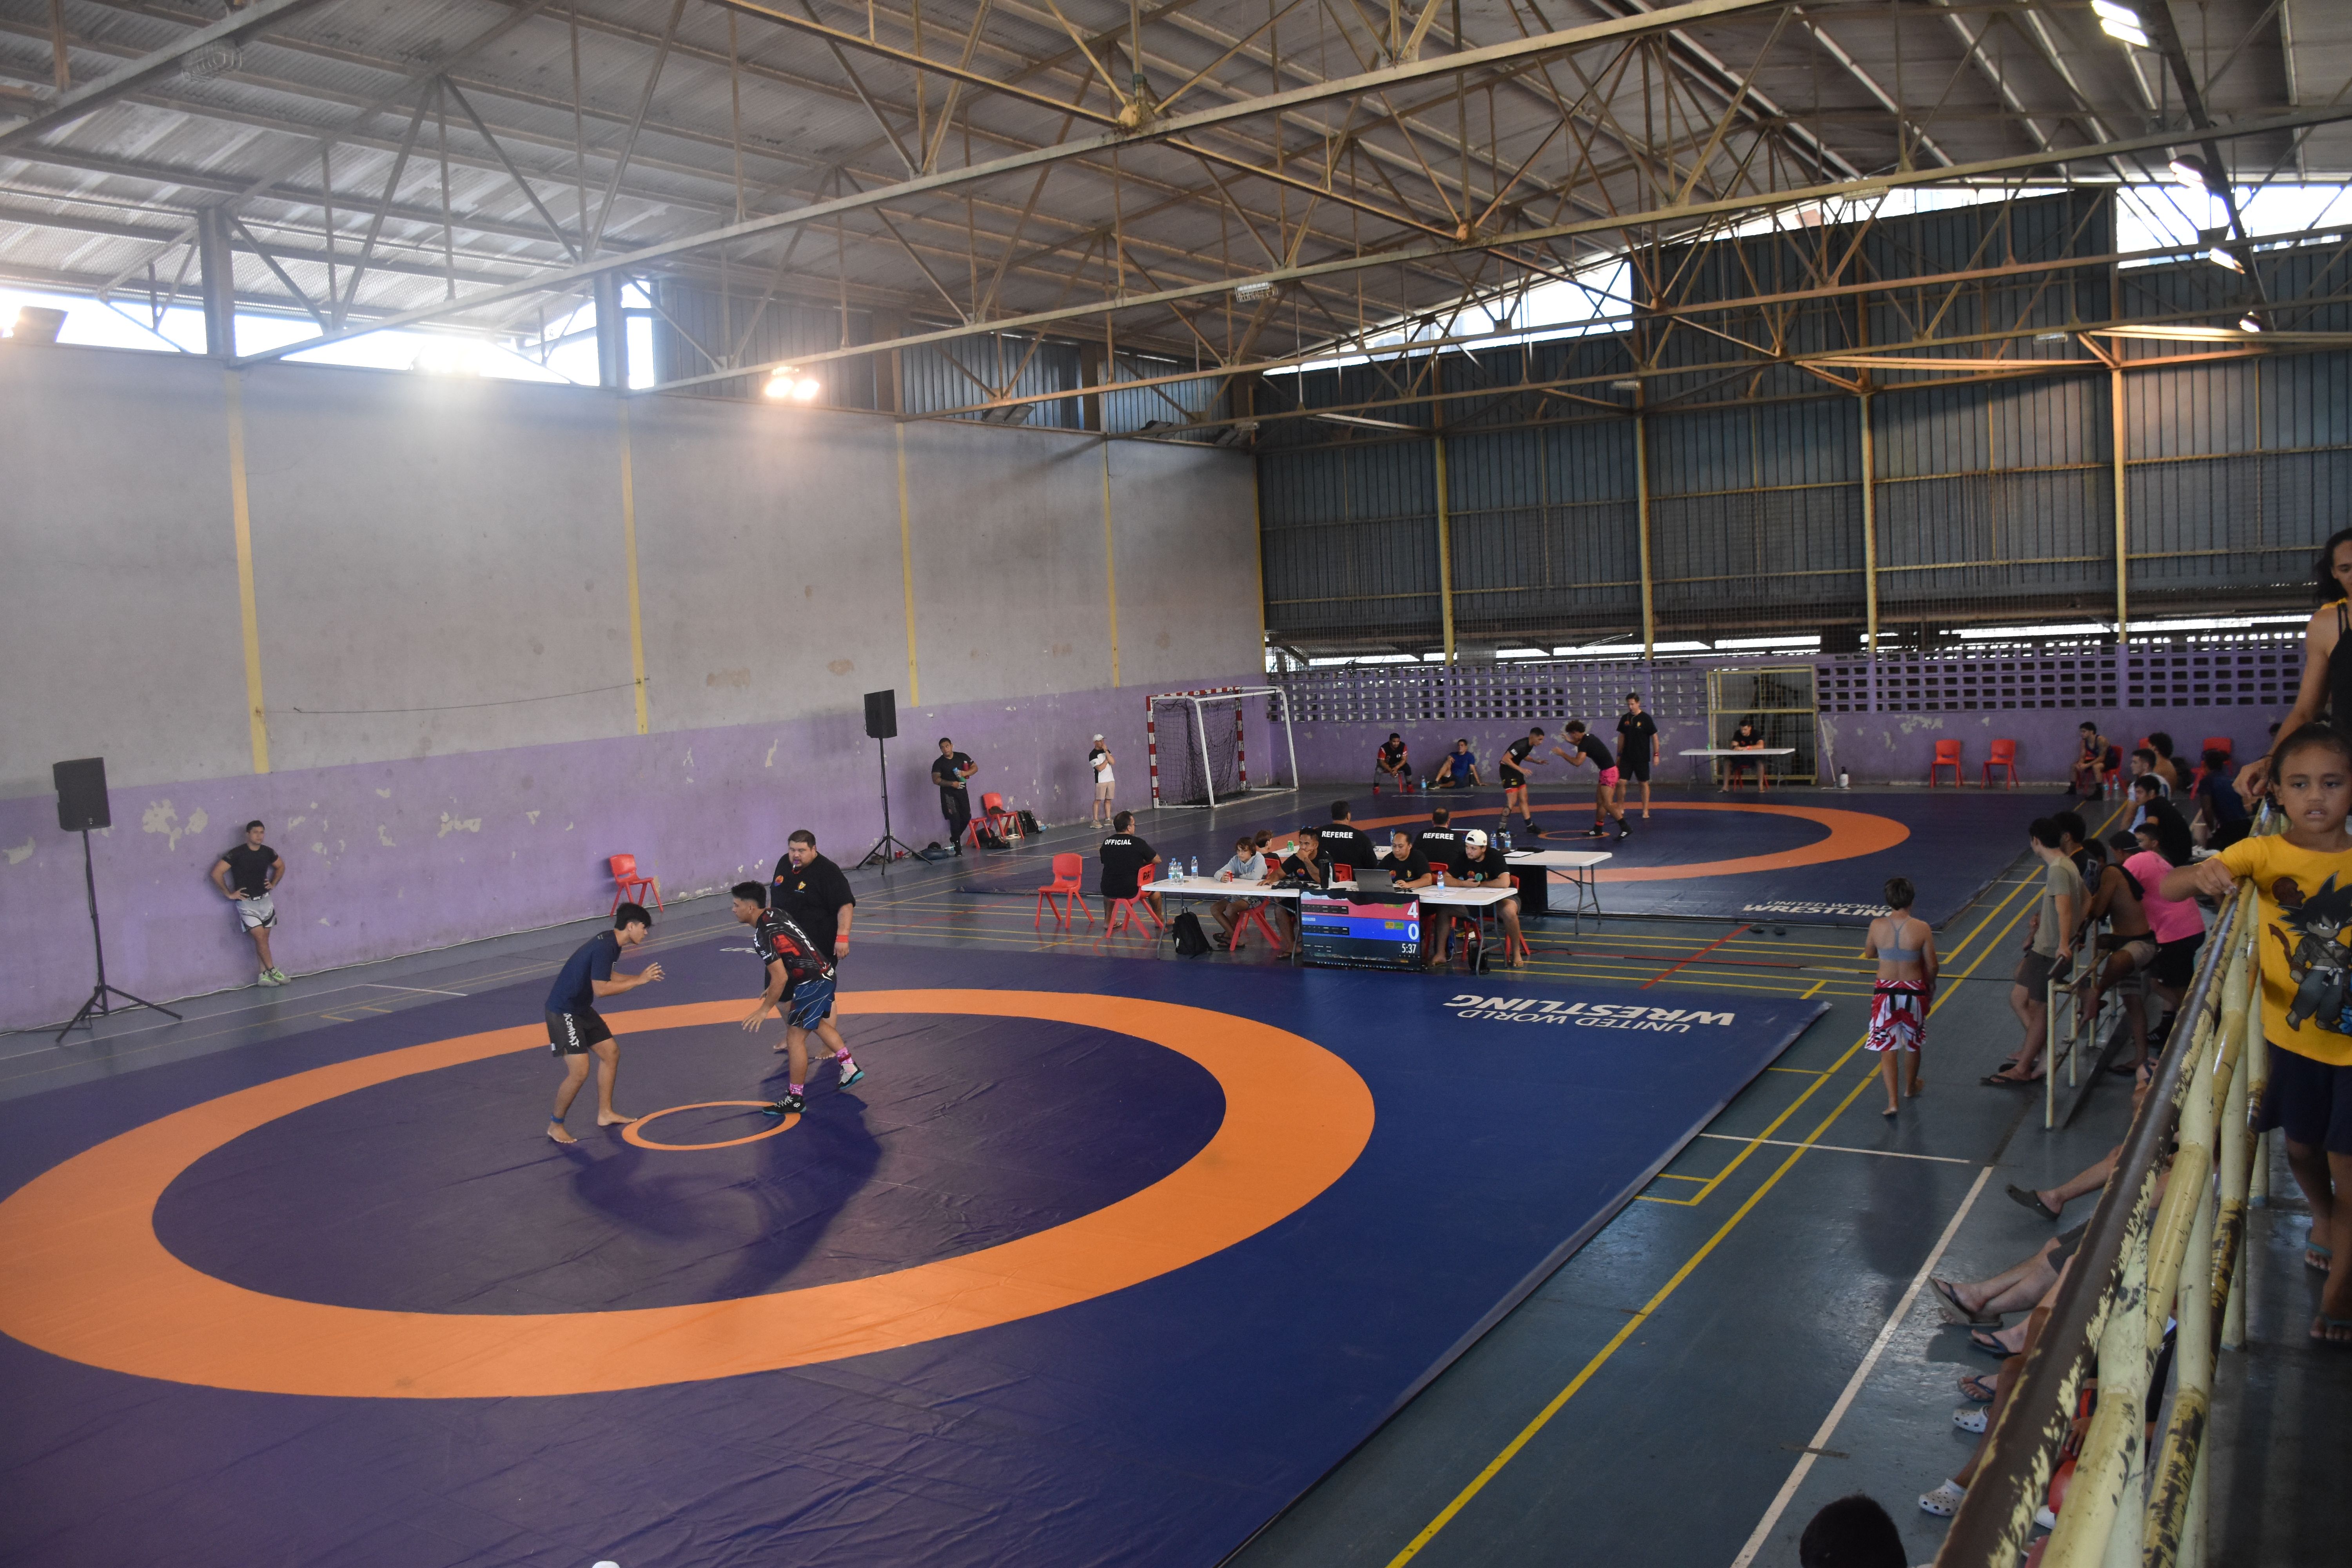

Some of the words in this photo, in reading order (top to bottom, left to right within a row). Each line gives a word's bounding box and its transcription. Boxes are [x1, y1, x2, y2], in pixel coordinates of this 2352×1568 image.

[1321, 831, 1353, 839] REFEREE
[1407, 902, 1418, 918] 4
[1408, 923, 1419, 940] 0
[1402, 943, 1416, 953] 5:37
[1443, 995, 1735, 1025] WRESTLING
[1457, 1010, 1567, 1024] WORLD
[1575, 1018, 1690, 1033] UNITED
